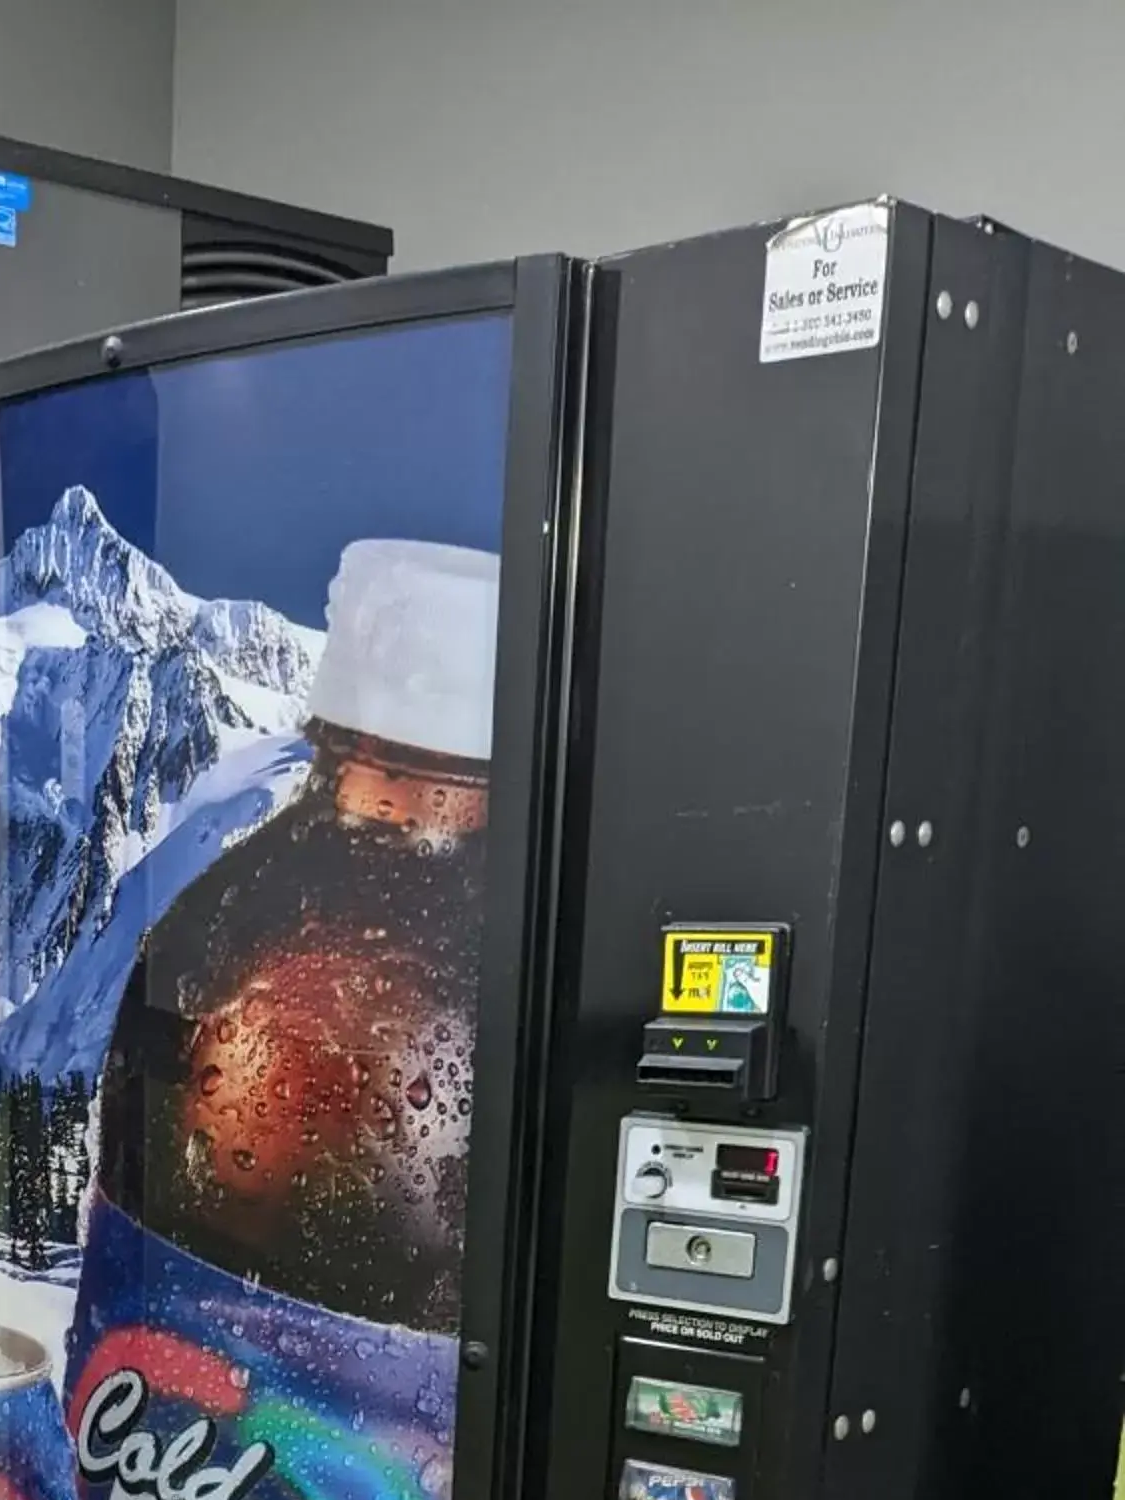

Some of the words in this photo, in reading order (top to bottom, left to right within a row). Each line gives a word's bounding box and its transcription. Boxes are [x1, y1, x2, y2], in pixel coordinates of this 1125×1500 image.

[813, 259, 837, 279] For
[769, 289, 804, 311] Sales
[808, 292, 823, 305] or
[826, 278, 879, 303] Service
[628, 1308, 660, 1321] PRESS
[662, 1313, 714, 1329] SELECTION
[715, 1321, 727, 1331] TO
[729, 1323, 768, 1338] DISPLAY
[650, 1321, 678, 1335] PRICE
[680, 1326, 695, 1336] OR
[696, 1328, 722, 1341] SOLD
[723, 1332, 745, 1344] OUT
